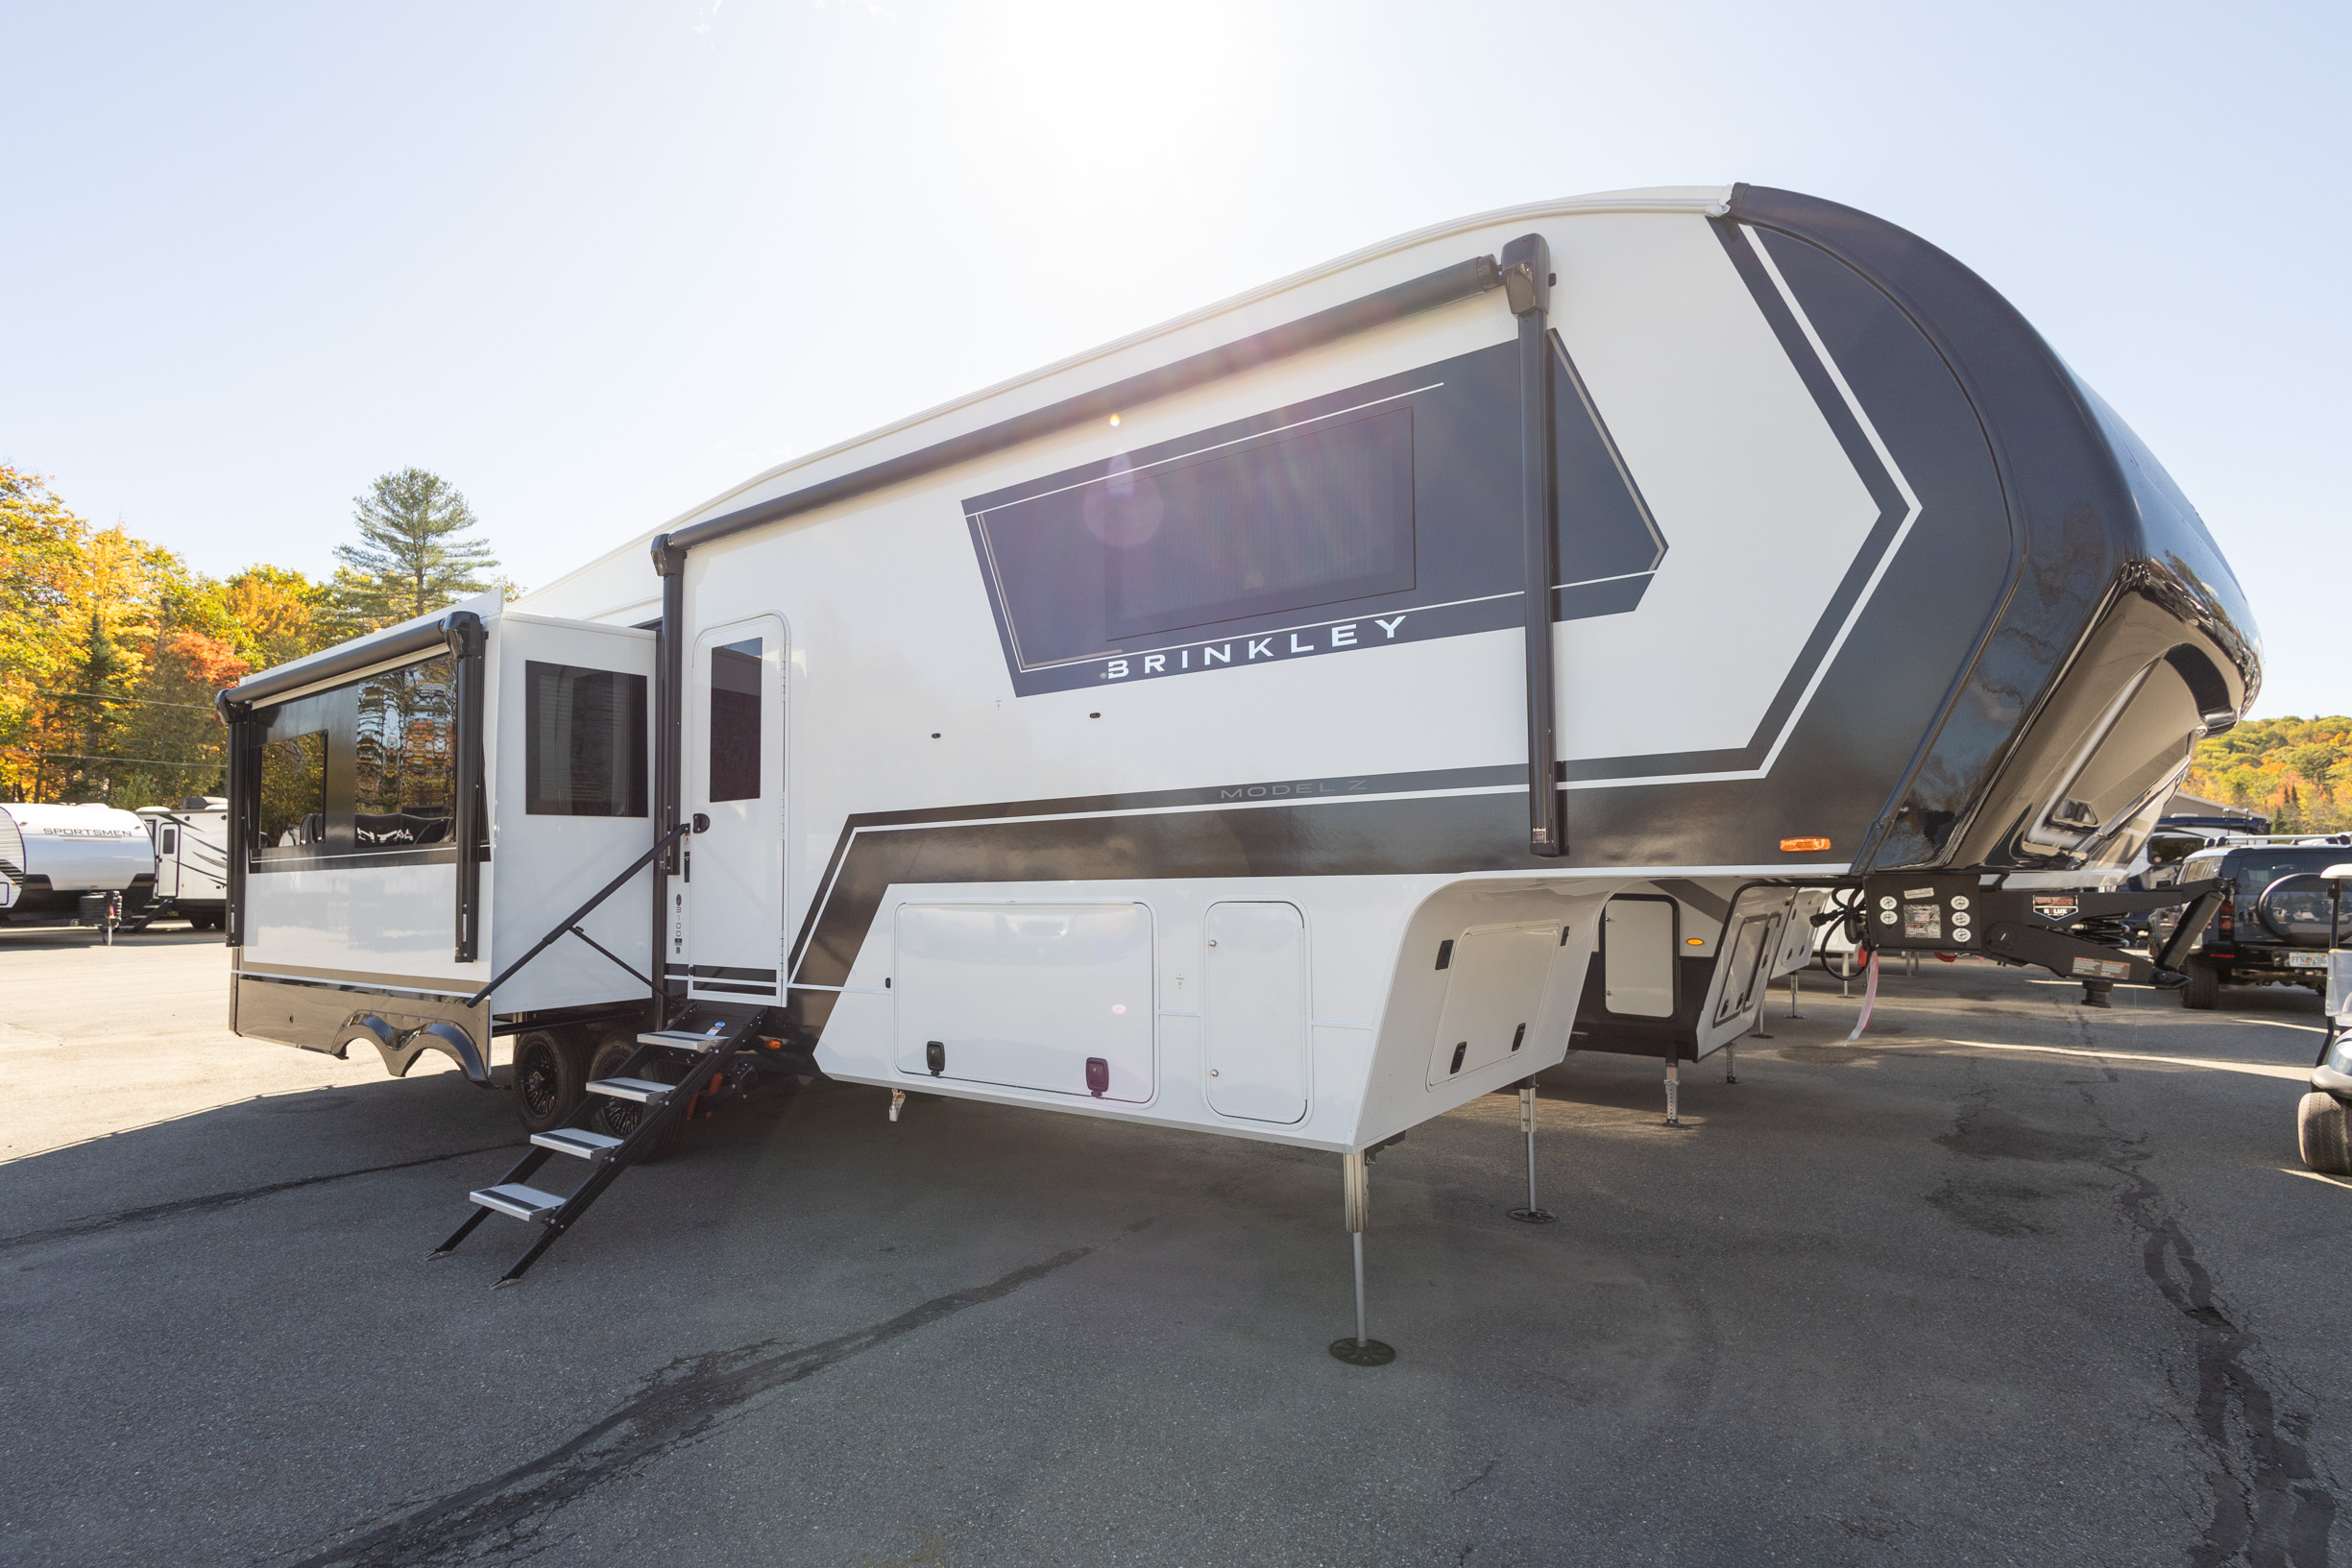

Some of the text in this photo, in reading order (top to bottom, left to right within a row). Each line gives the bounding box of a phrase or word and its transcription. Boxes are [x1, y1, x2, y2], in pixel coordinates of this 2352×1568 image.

[1107, 615, 1407, 680] BRINKLEY
[1221, 779, 1368, 800] MODEL Z
[43, 828, 133, 837] SPORTSMEN
